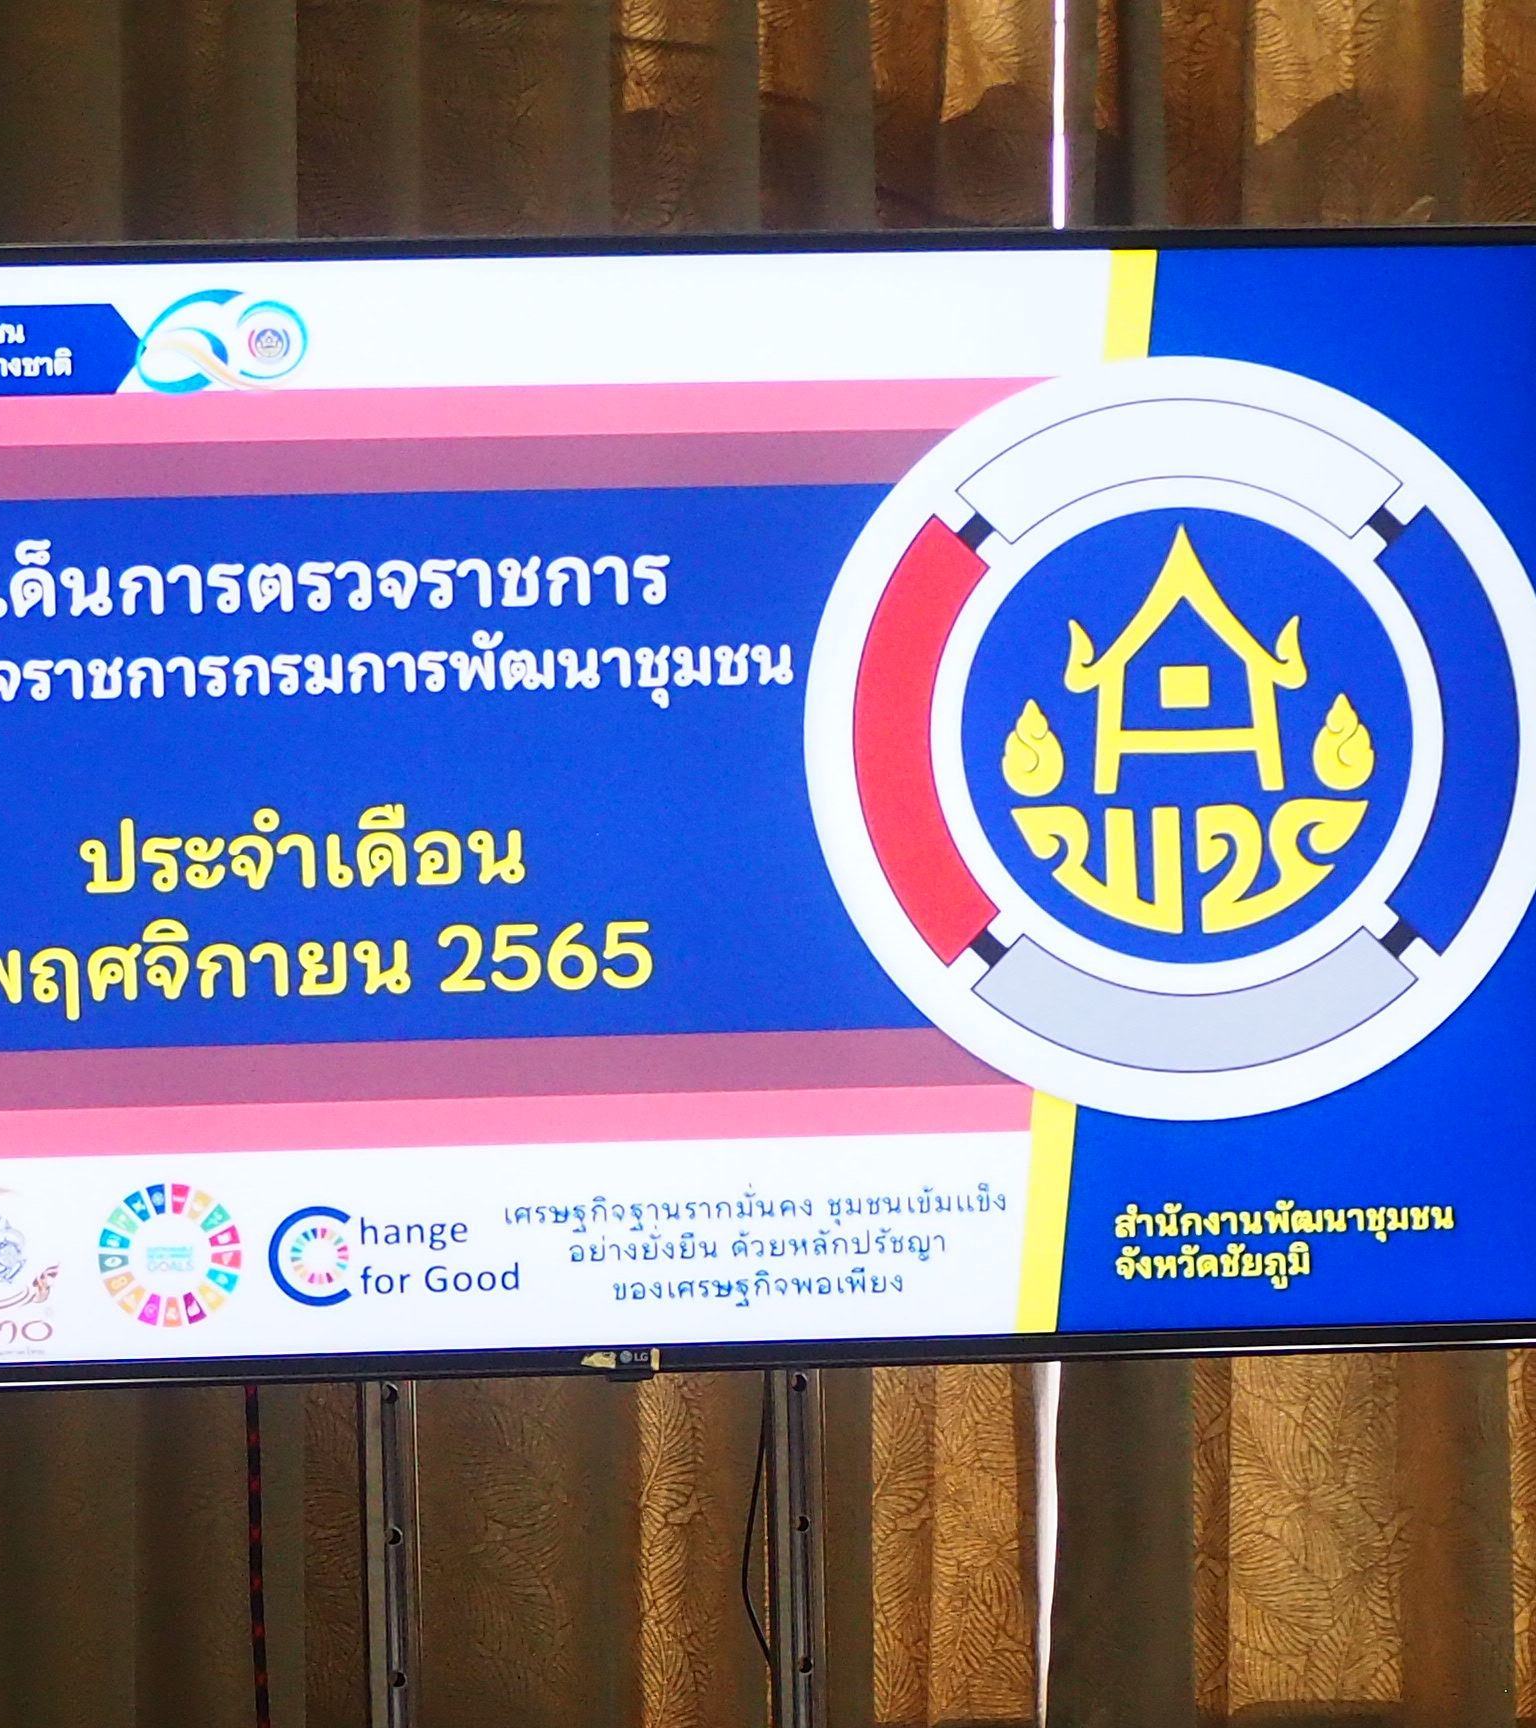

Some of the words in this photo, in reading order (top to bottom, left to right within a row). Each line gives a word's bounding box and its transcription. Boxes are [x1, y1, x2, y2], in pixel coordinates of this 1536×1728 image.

[78, 803, 526, 894] ประจำเดือน
[437, 920, 654, 994] 2565
[504, 1184, 814, 1233] เศรษฐกิจฐานรากมั่นคง
[826, 1182, 1008, 1227] ชุมชนเข้มแข็ง
[1114, 1199, 1455, 1243] สำนักงานพัฒนาชุมชน
[569, 1224, 718, 1264] อย่างยั่งยืน
[731, 1227, 947, 1262] ด้วยหลักปรัชญา
[1115, 1241, 1311, 1290] จังหวัดชัยภูมิ
[360, 1265, 411, 1296] for
[424, 1261, 520, 1294] Good
[613, 1266, 904, 1307] ของเศรษฐกิจพอเพียง
